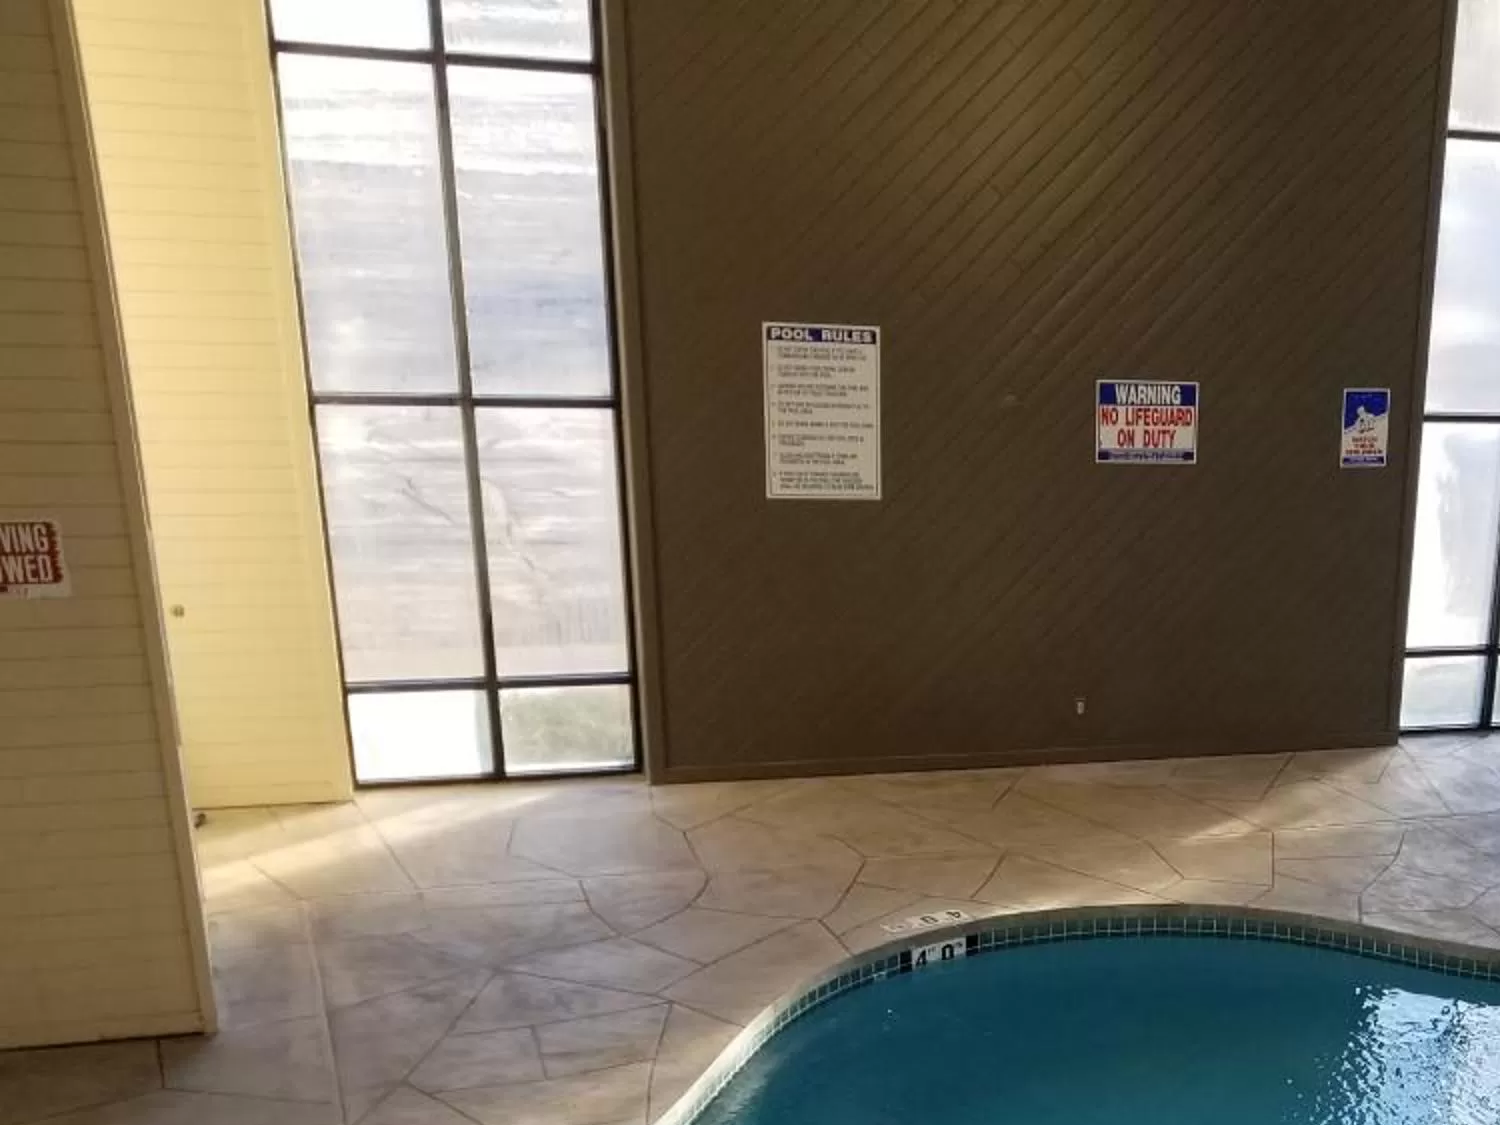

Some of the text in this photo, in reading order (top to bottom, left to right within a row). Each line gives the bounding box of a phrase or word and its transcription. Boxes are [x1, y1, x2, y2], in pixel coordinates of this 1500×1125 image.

[771, 327, 873, 343] POOL RULES
[1115, 383, 1181, 405] WARNING
[1101, 407, 1193, 427] NO LIFEGUARD
[1117, 428, 1177, 448] ON DUTY
[0, 555, 53, 583] WED
